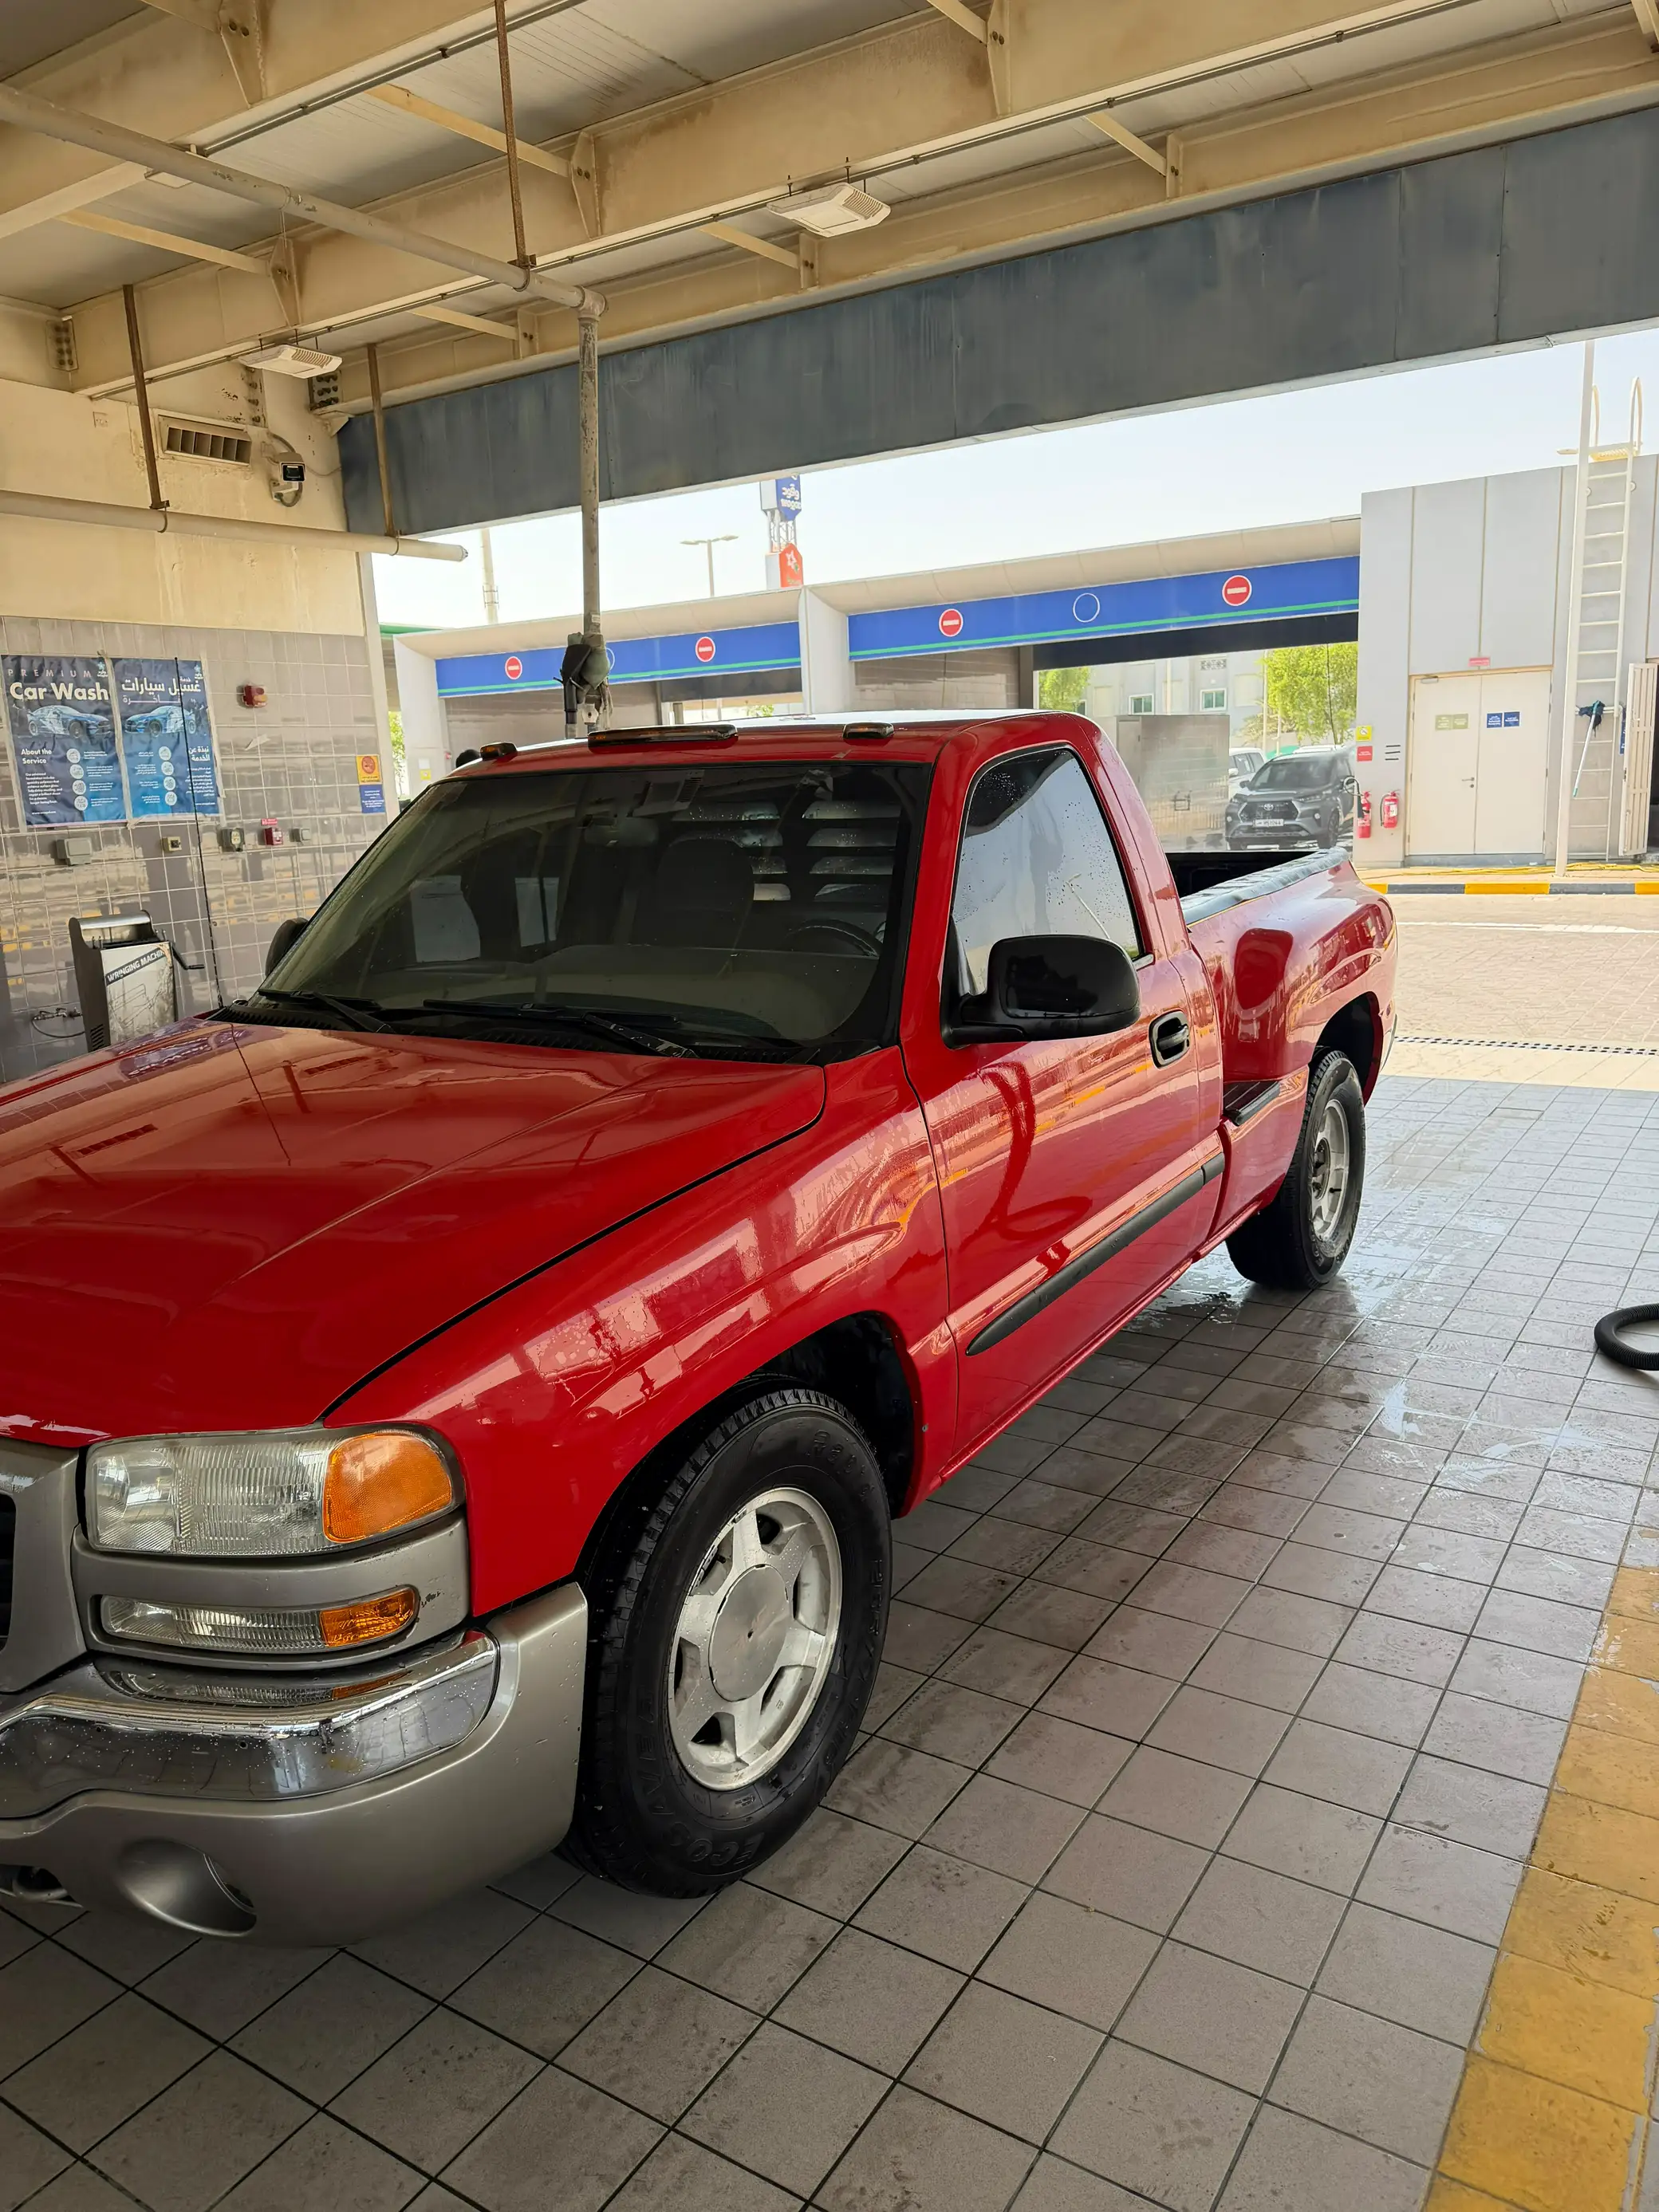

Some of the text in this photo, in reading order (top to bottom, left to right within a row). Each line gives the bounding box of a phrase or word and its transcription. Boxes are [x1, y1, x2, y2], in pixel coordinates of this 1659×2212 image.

[8, 669, 92, 678] PREMIUM
[10, 682, 109, 700] Car Wash
[121, 677, 202, 696] غسيل سيارات
[107, 949, 165, 982] WRINGING MACHIN
